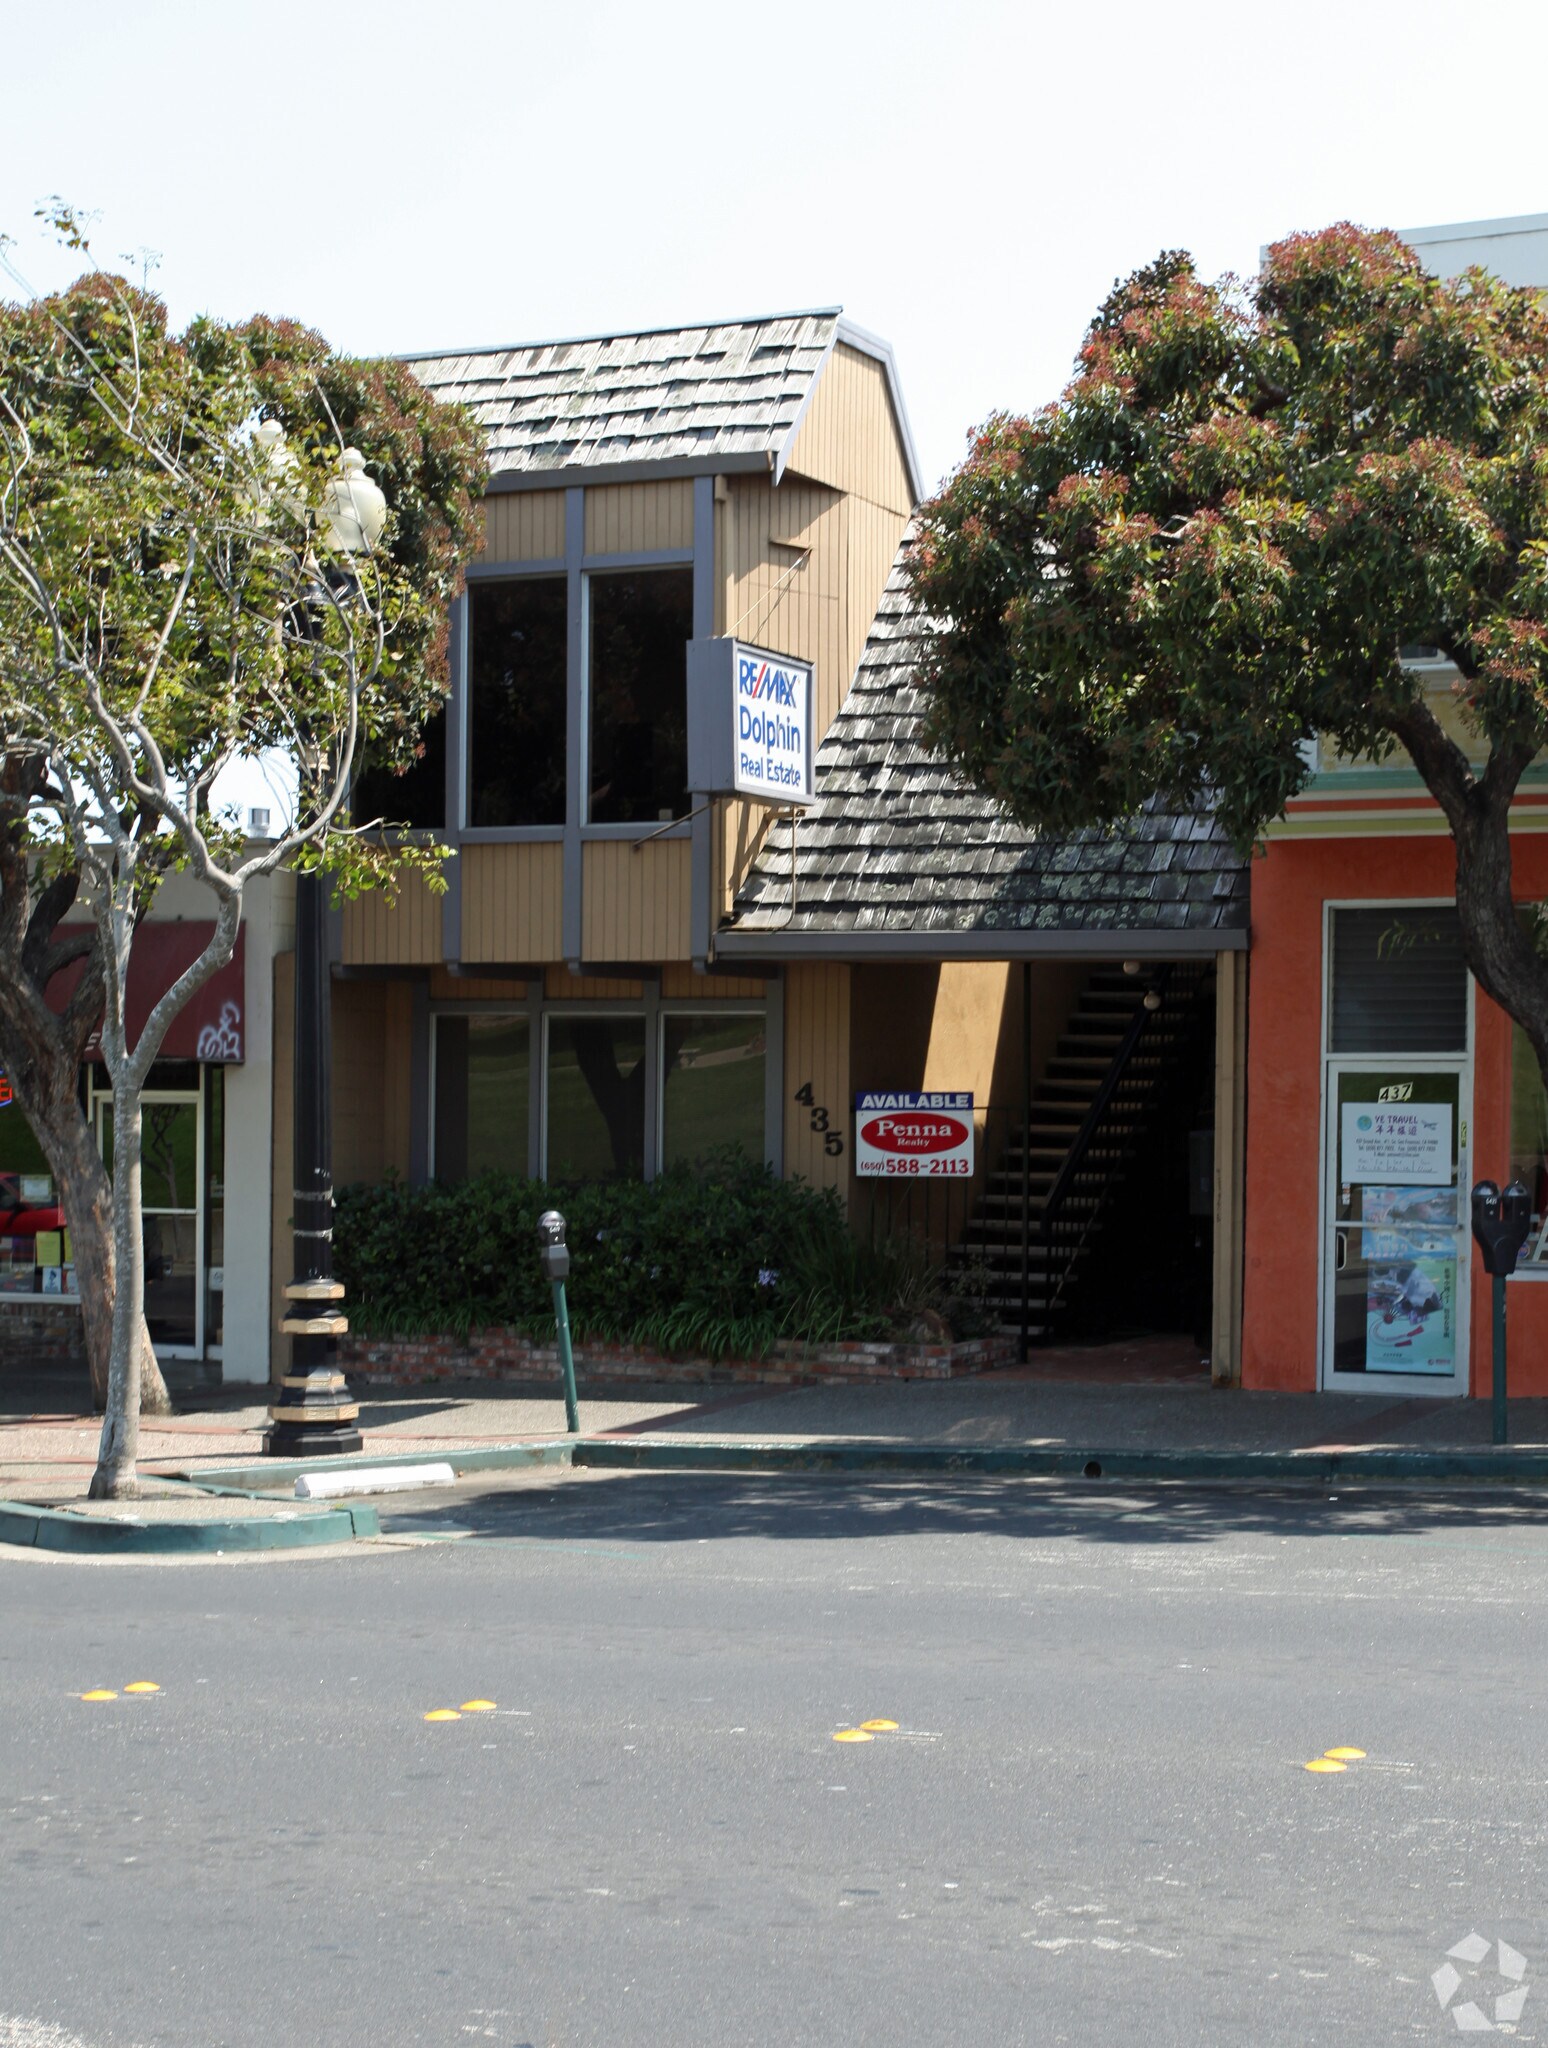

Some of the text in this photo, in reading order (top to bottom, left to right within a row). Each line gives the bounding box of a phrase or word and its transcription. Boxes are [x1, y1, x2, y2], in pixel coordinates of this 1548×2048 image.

[739, 659, 798, 709] RE/MAX
[739, 705, 801, 754] Dolphin
[740, 752, 801, 787] Real Estate
[1379, 1084, 1411, 1101] 437
[861, 1094, 969, 1109] AVAILABLE
[794, 1081, 844, 1157] 435
[1388, 1115, 1418, 1124] TRAVEL
[876, 1119, 952, 1137] Penna
[897, 1138, 930, 1148] Realty
[860, 1159, 969, 1175] (650) 588-2113
